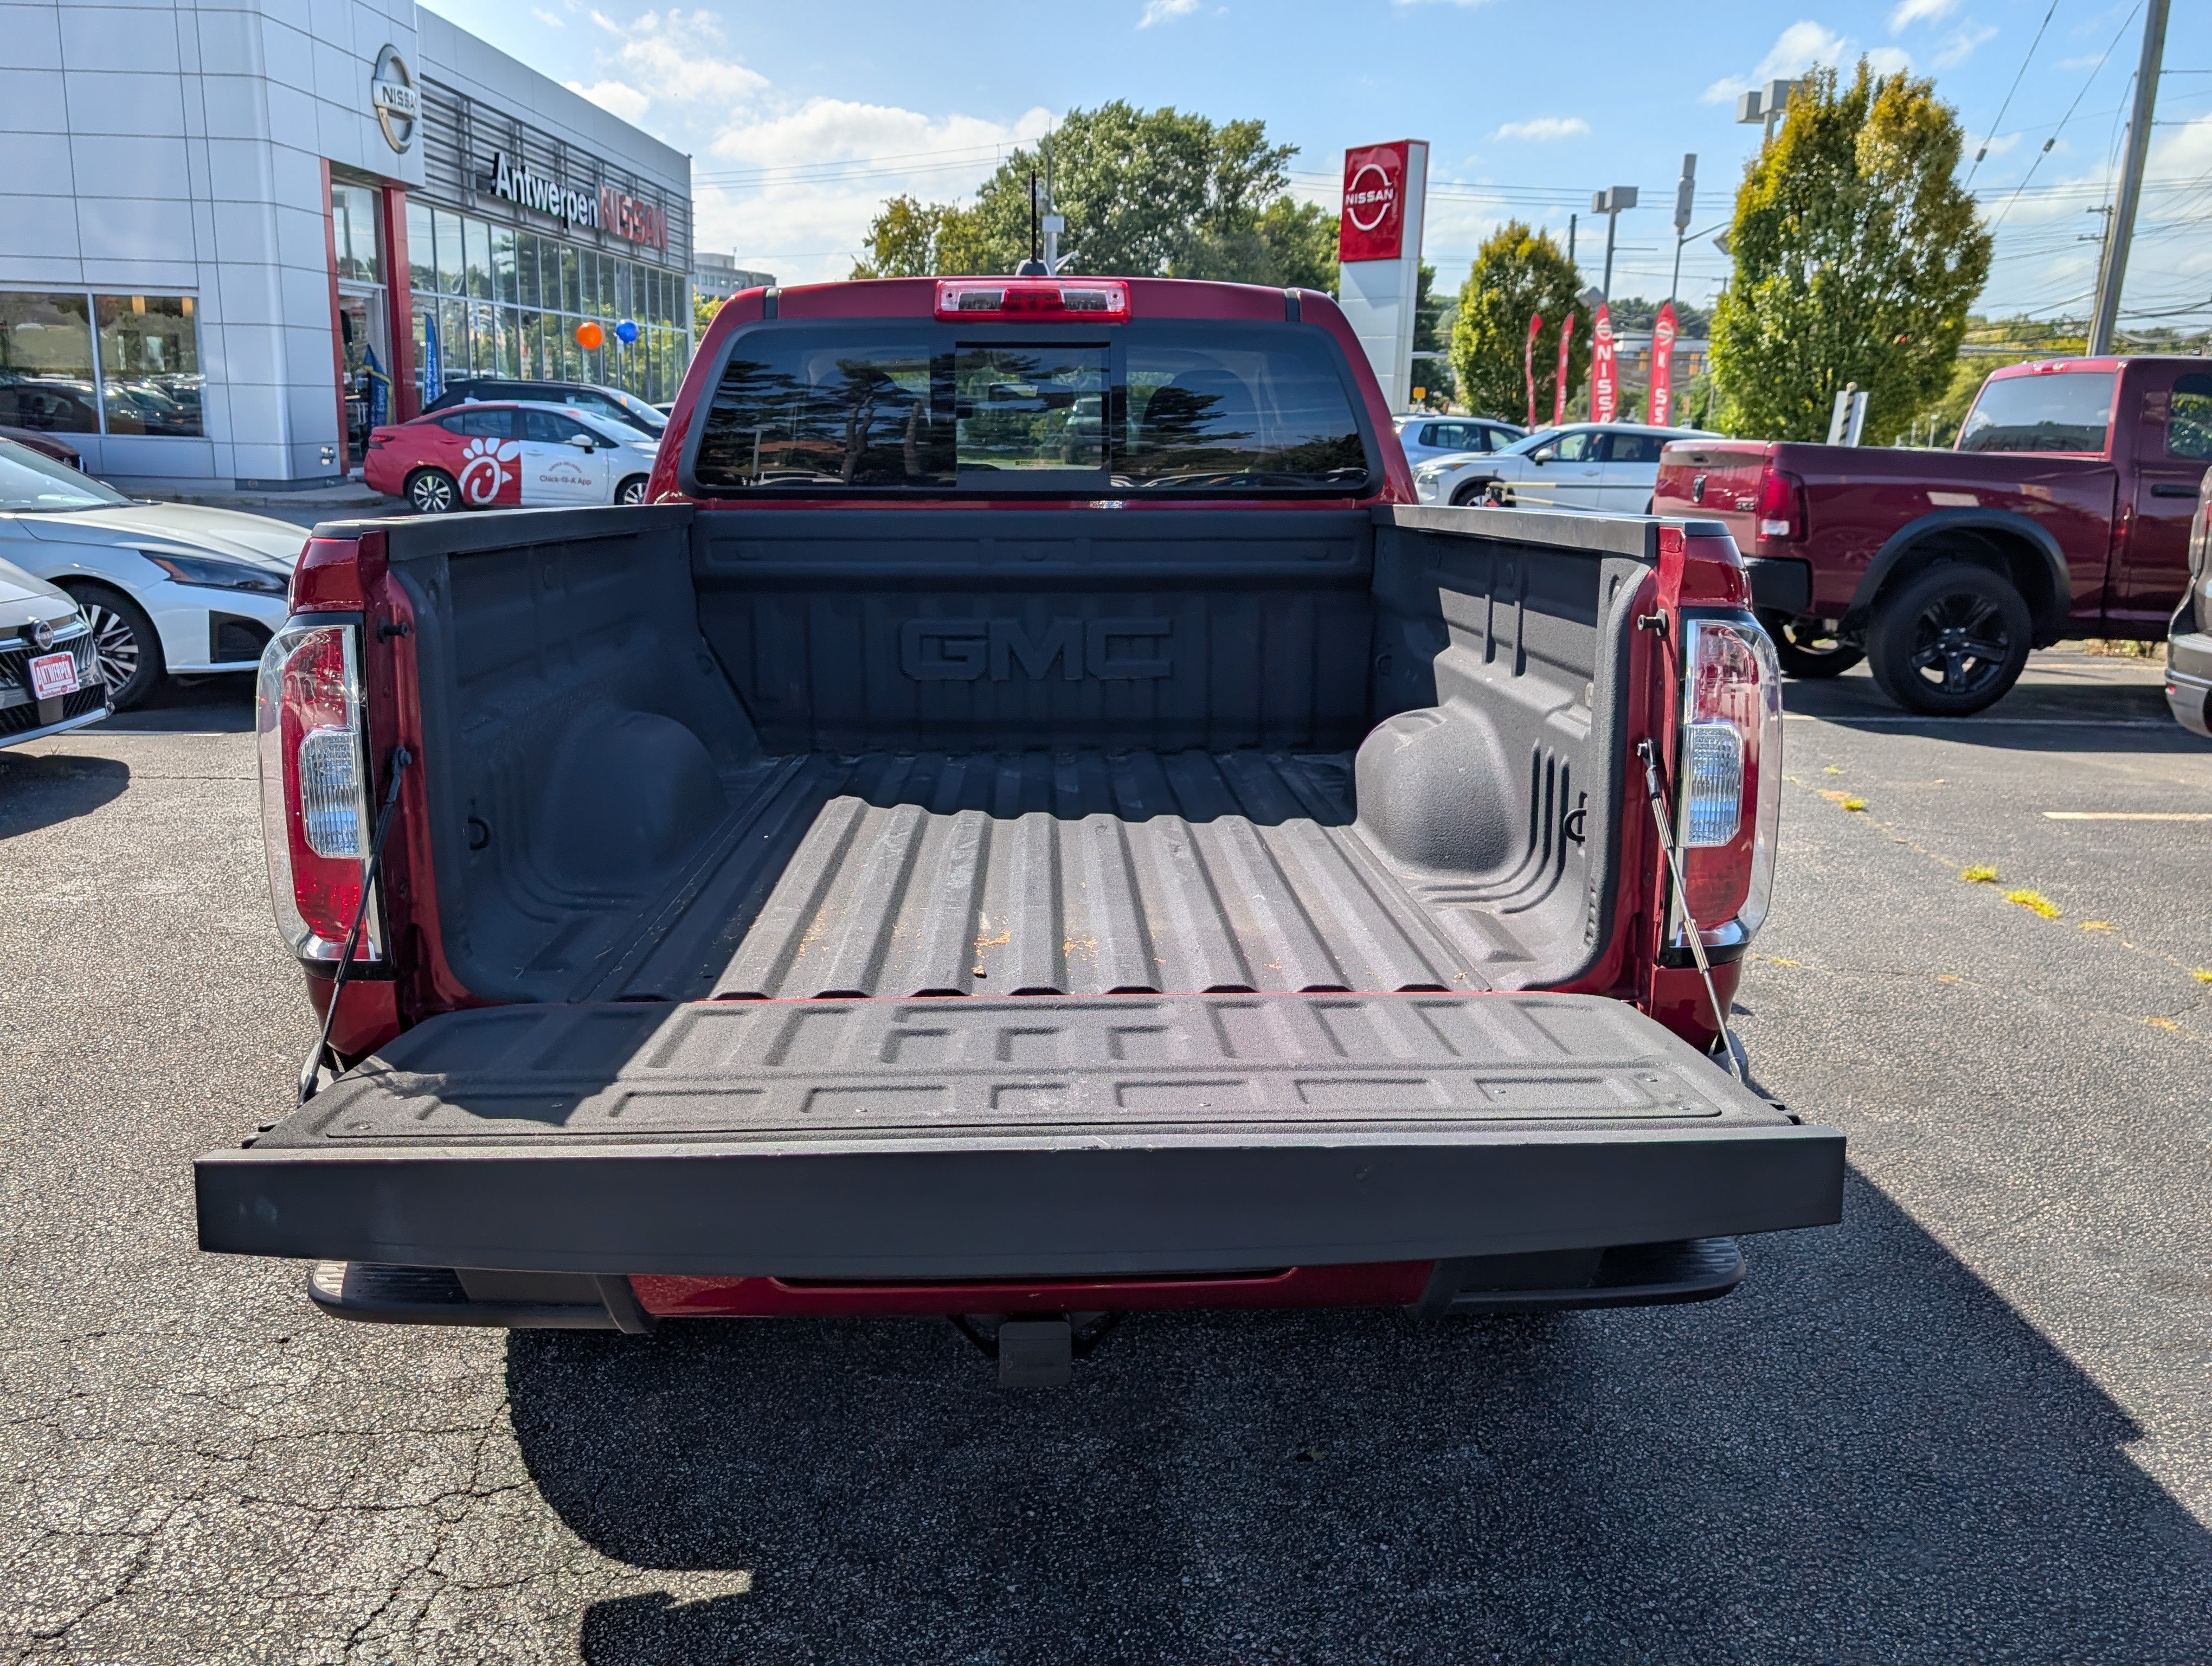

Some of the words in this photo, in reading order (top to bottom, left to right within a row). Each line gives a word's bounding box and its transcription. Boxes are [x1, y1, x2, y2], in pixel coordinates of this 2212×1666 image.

[492, 151, 597, 230] Antwerpen
[600, 184, 668, 251] NISSAN
[1345, 188, 1394, 206] NISSAN
[1596, 344, 1613, 424] NISSA
[539, 475, 576, 483] Chick-fil-A
[578, 477, 591, 485] App
[898, 617, 1173, 682] GMC
